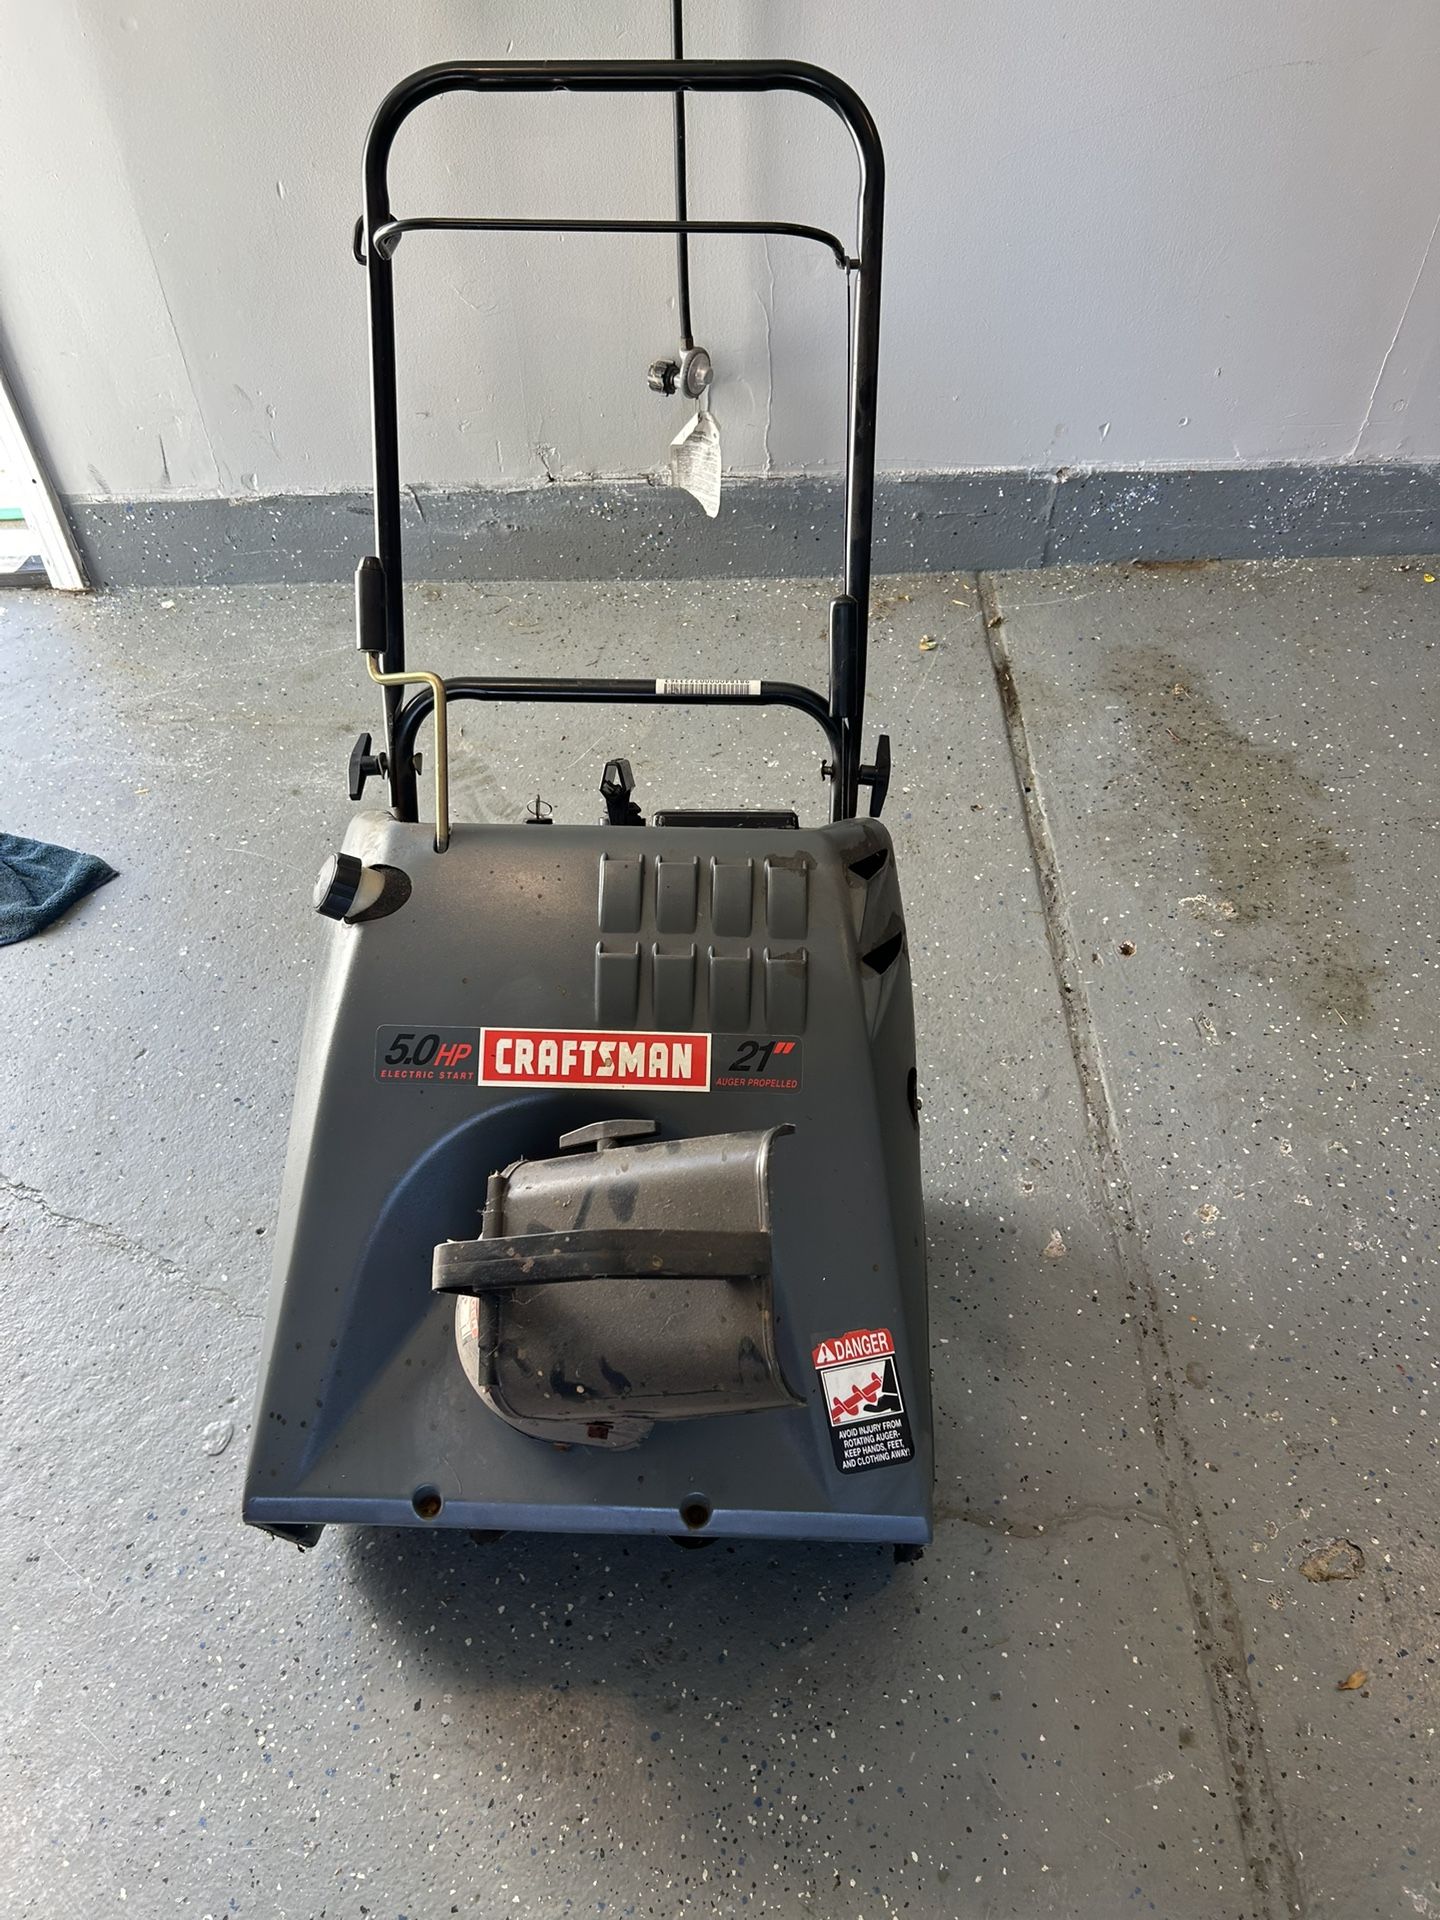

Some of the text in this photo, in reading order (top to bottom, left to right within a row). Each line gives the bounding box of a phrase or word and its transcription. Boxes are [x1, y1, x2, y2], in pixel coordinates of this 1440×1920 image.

[495, 1038, 693, 1079] CRAFTSMAN
[380, 1069, 475, 1080] ELECTRIC START
[716, 1078, 798, 1089] AUGER PROPELLED
[834, 1331, 890, 1361] DANGER
[839, 1419, 902, 1439] AVOID INJURY FROM
[843, 1434, 875, 1448] ROTATING
[842, 1447, 911, 1470] AND CLOTHING AWAY!
[844, 1446, 862, 1459] KEEP
